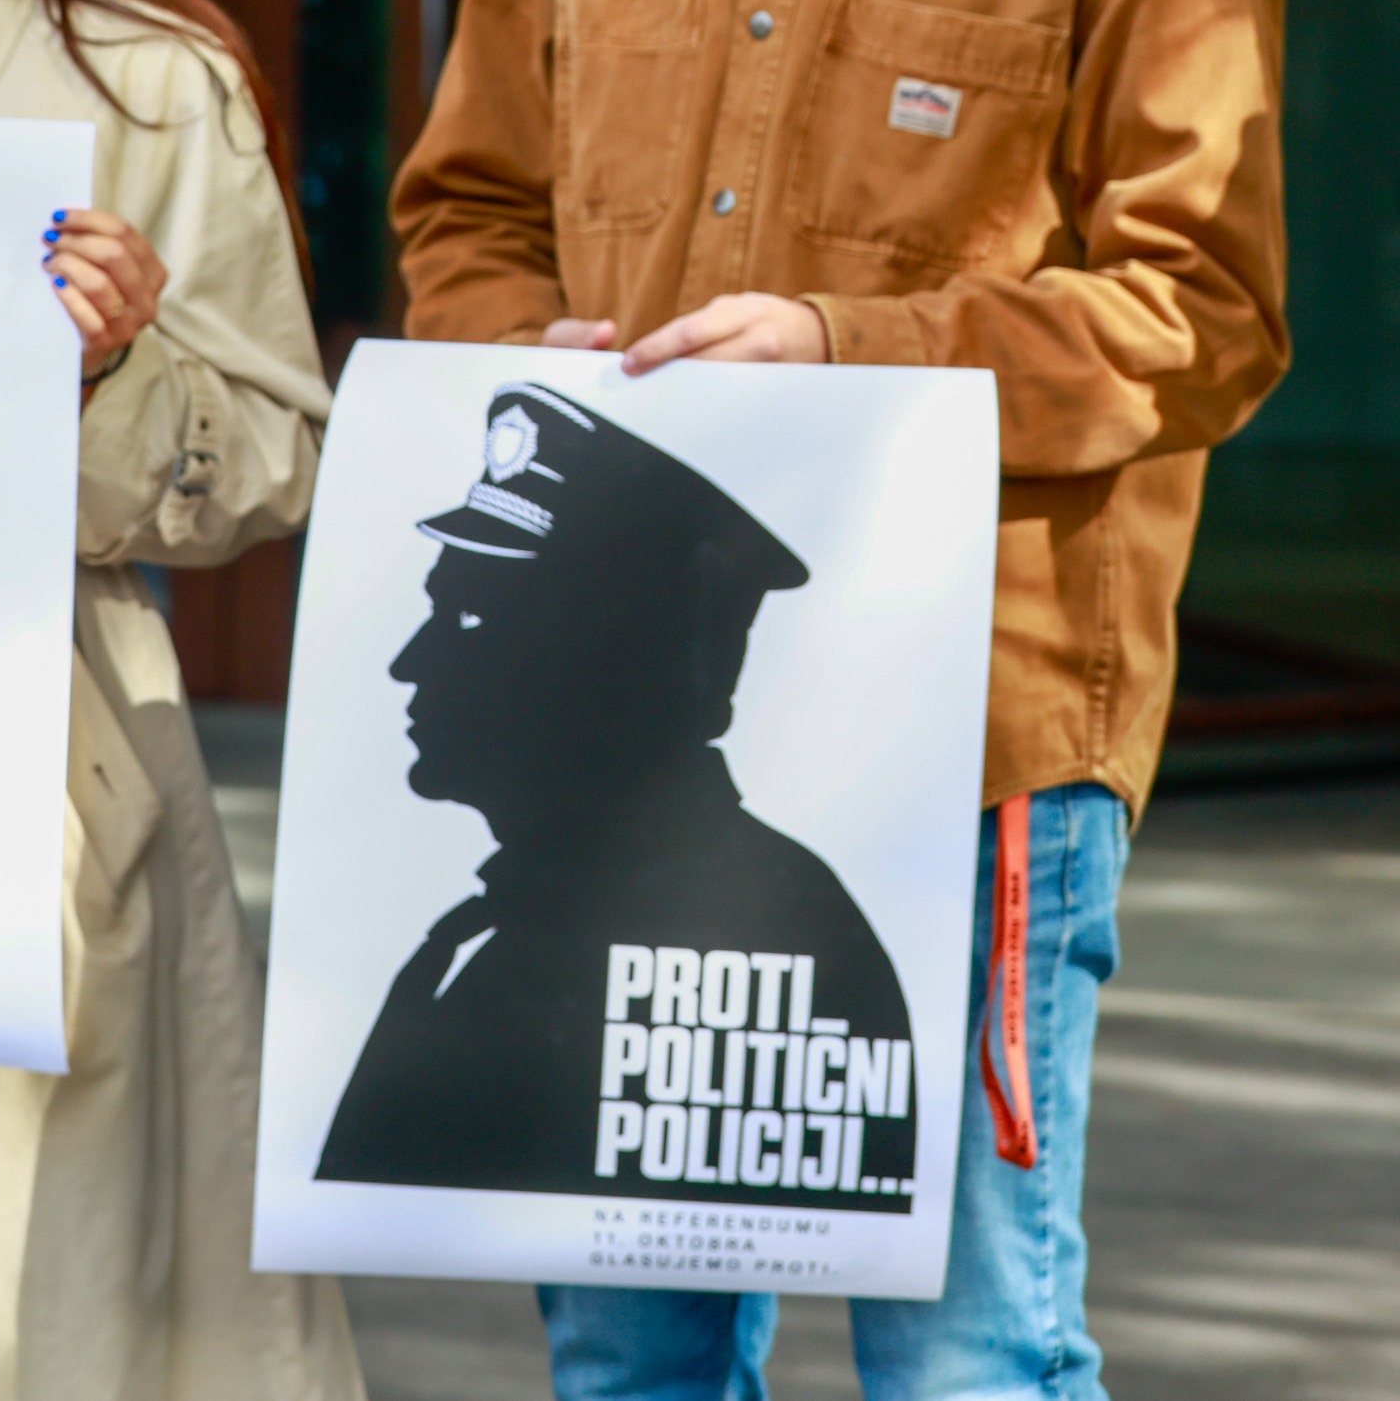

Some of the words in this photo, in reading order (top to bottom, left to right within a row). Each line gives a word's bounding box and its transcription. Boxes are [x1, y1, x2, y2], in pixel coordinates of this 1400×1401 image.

[593, 1208, 625, 1223] NA
[639, 1210, 831, 1235] REFERENDUMU
[638, 1232, 756, 1253] OKTOBRA
[589, 1251, 742, 1274] GLASUJEMO
